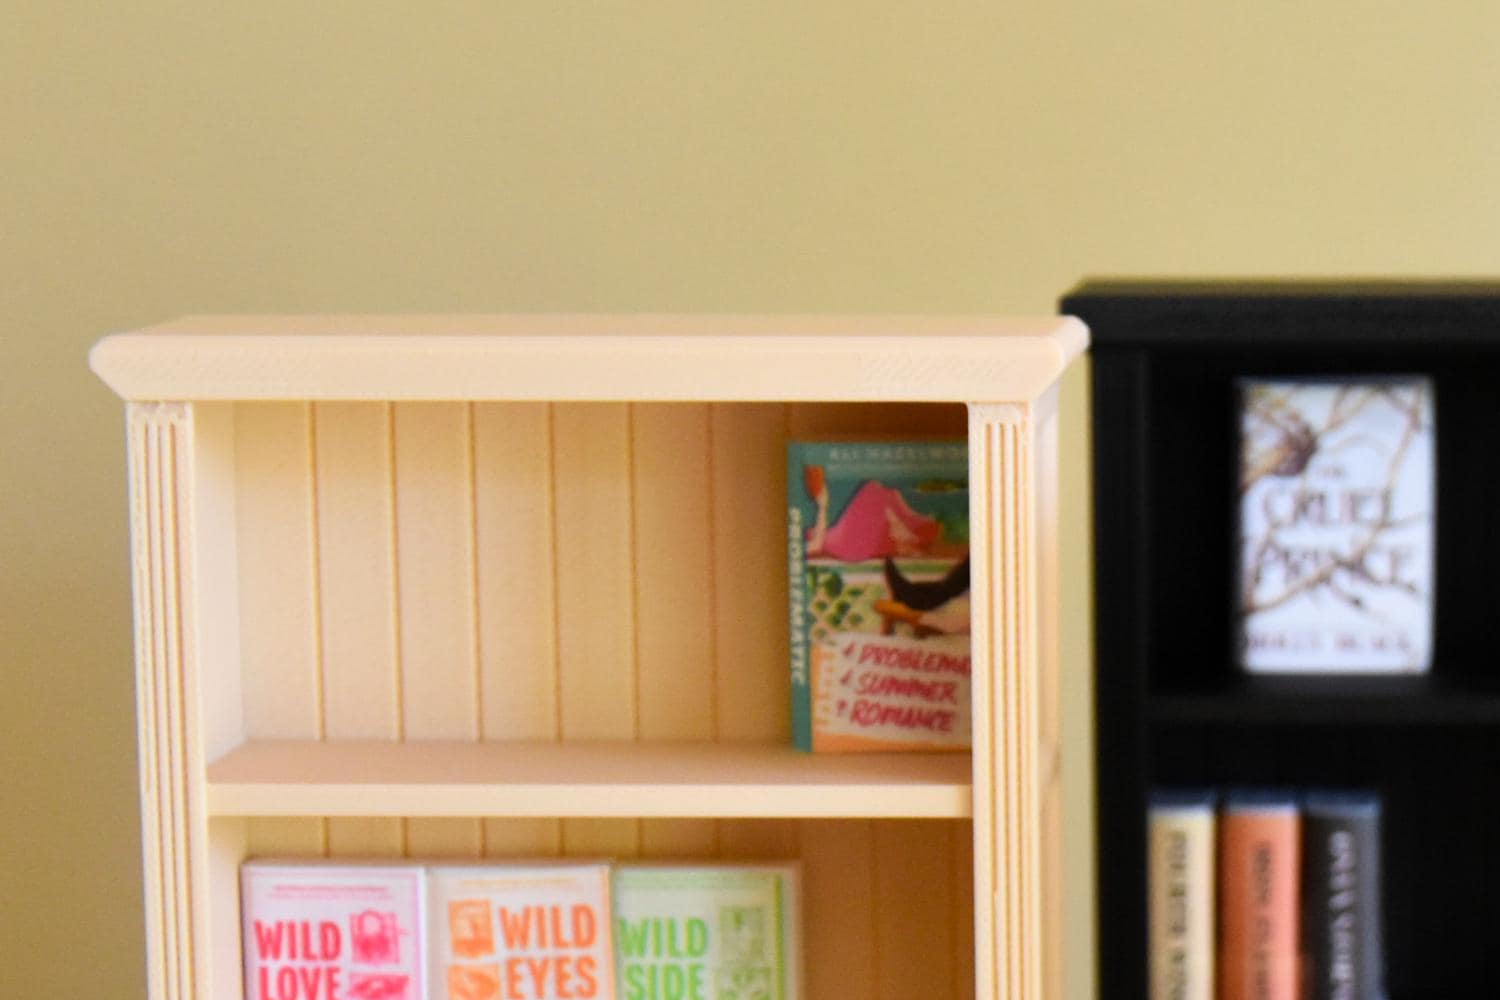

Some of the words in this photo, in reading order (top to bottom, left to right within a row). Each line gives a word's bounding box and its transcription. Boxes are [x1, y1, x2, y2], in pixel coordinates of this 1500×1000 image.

[253, 919, 342, 961] WILD
[498, 903, 597, 949] WILD
[619, 916, 710, 959] WILD
[506, 955, 598, 1000] EYES
